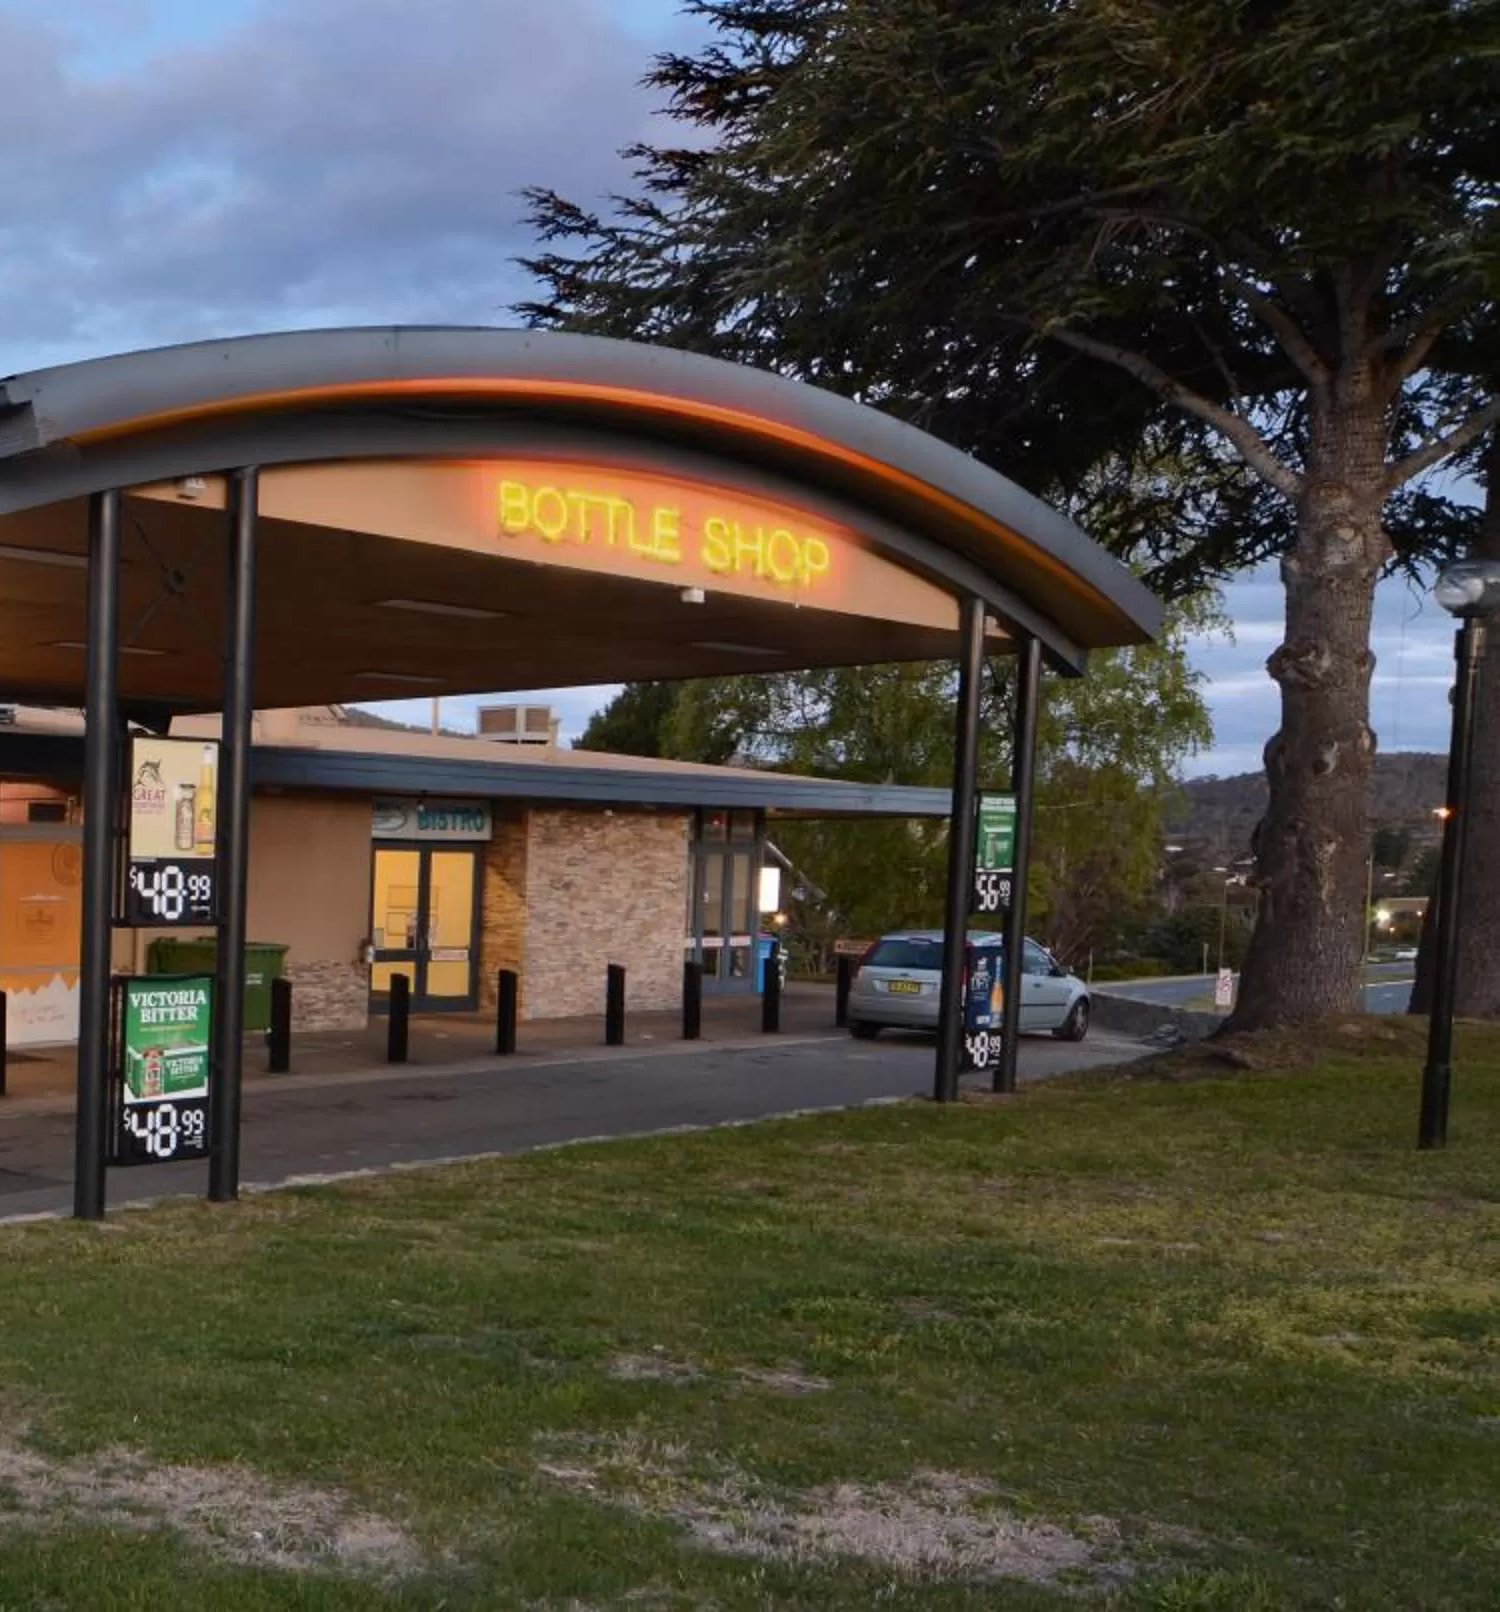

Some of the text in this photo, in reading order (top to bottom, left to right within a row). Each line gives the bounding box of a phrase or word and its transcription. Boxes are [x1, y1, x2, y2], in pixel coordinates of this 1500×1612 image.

[500, 480, 830, 586] BOTTLE SHOP
[133, 788, 165, 801] GREAT
[418, 807, 484, 832] BISTRO
[129, 989, 207, 1008] VICTORIA
[140, 1005, 199, 1023] BITTER
